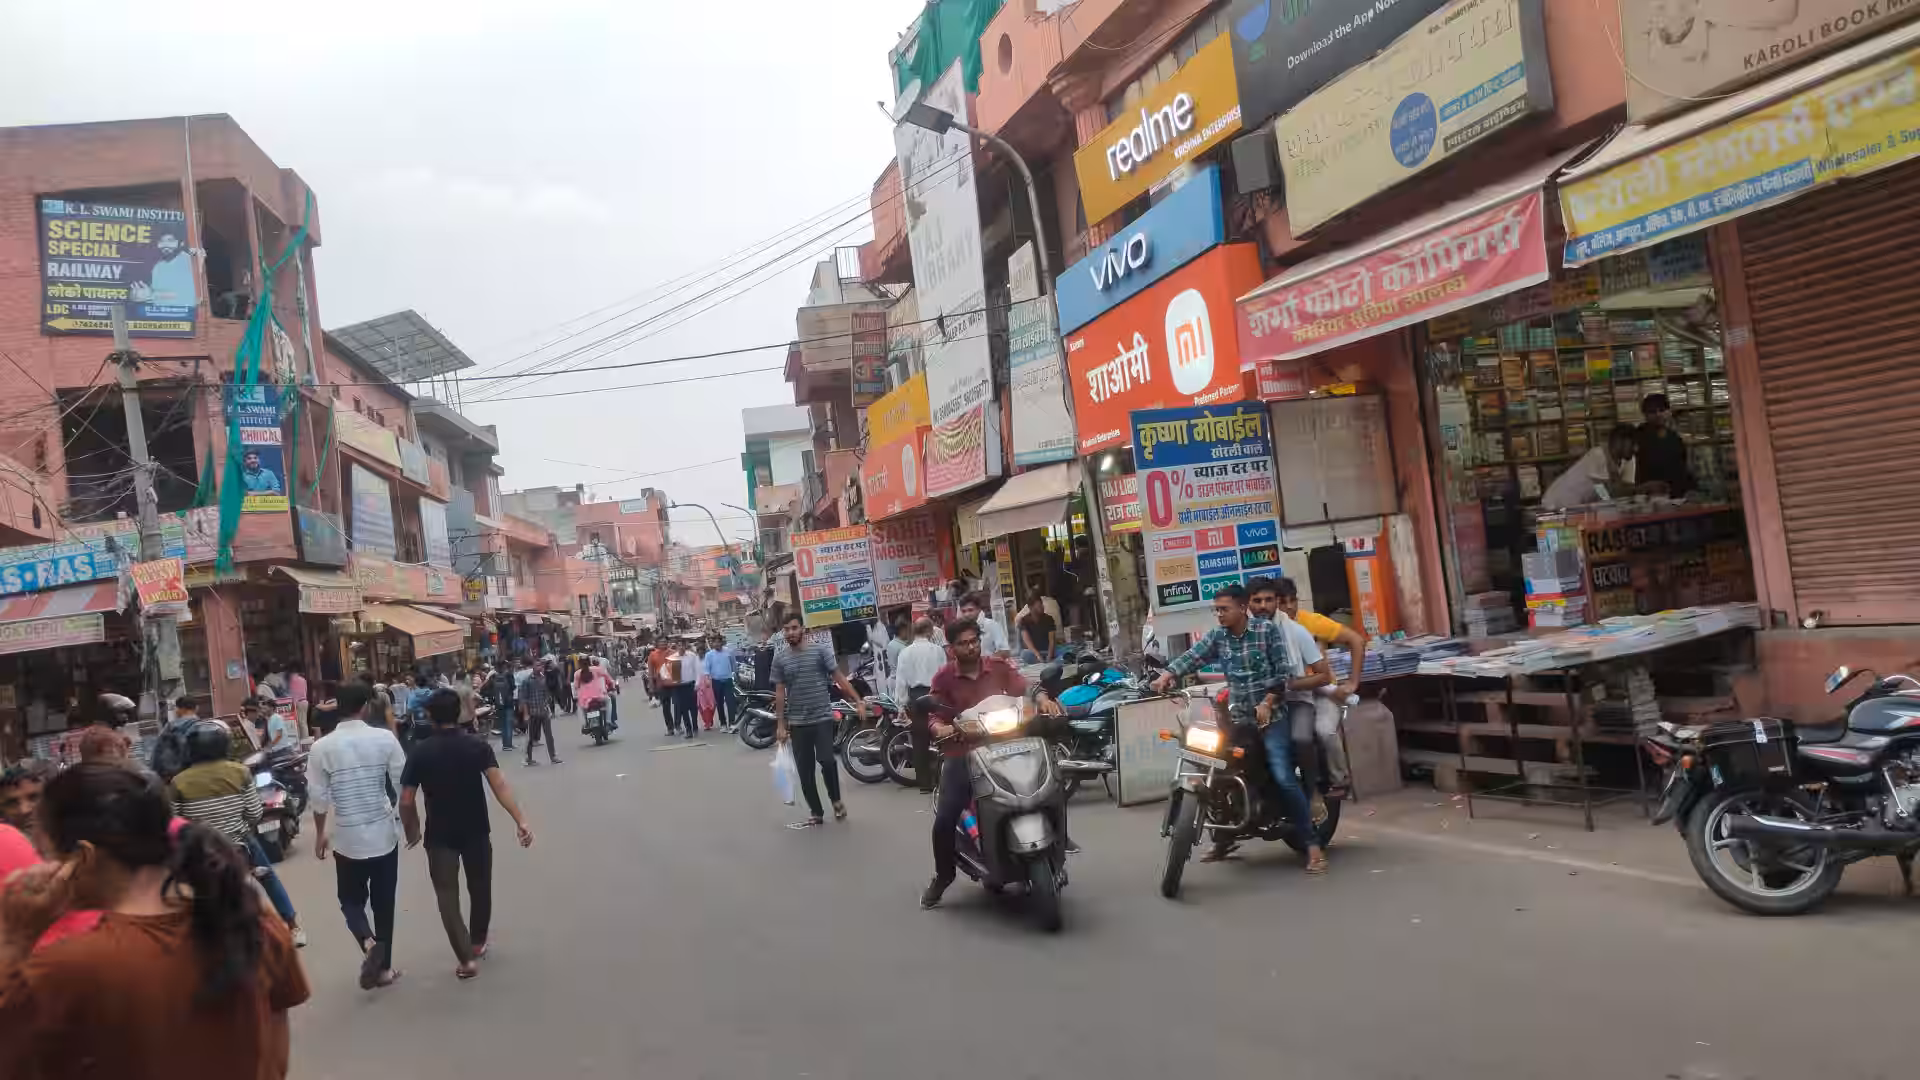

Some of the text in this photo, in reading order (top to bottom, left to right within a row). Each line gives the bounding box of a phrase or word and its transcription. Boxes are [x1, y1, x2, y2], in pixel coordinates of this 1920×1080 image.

[1286, 30, 1334, 70] Download
[1334, 22, 1352, 39] the
[1353, 8, 1375, 29] App
[1743, 29, 1815, 70] KAROLI
[1820, 1, 1881, 38] BOOK
[1106, 92, 1194, 181] realme
[1173, 136, 1202, 160] KRISHNA
[92, 207, 134, 219] SWAMI
[49, 220, 151, 244] SCIENCE
[48, 240, 121, 258] SPECIAL
[1089, 232, 1146, 290] vivo
[47, 262, 123, 280] RAILWAY
[46, 304, 70, 315] LDC
[1087, 331, 1151, 403] शाओमी
[1190, 407, 1262, 443] मोबाईल
[1193, 458, 1268, 478] ब्याज दर पर
[1200, 555, 1237, 569] SAMSUNG
[1163, 582, 1192, 597] Infinix
